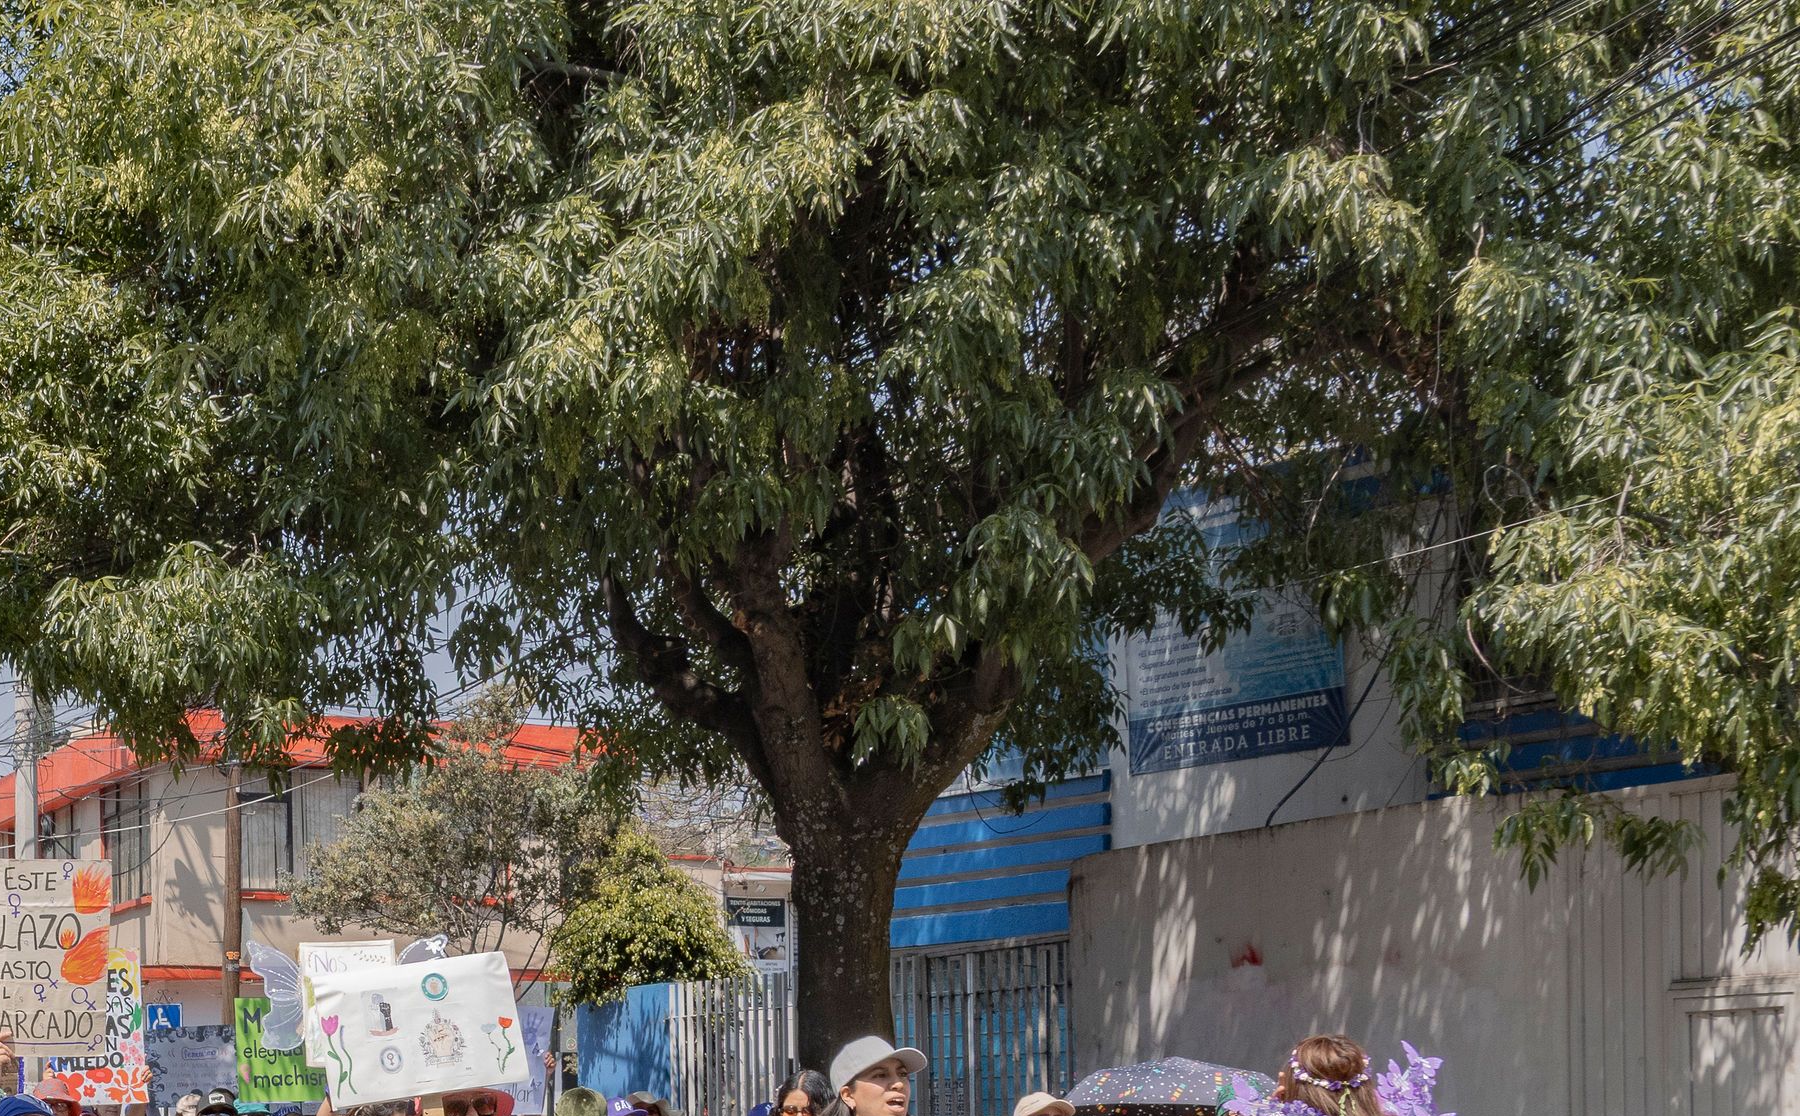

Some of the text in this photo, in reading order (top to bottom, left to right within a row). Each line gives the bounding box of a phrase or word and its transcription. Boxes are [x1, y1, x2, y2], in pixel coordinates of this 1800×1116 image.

[1147, 694, 1328, 733] CONFERENCIAS PERMANENTES
[1161, 729, 1195, 742] Martes
[1205, 721, 1240, 735] Jueves
[1242, 719, 1255, 730] de
[1259, 717, 1265, 726] 7
[1268, 715, 1276, 725] a
[1278, 714, 1284, 724] 8
[1163, 724, 1311, 761] ENTRADA LIBRE
[4, 866, 57, 891] ESTE
